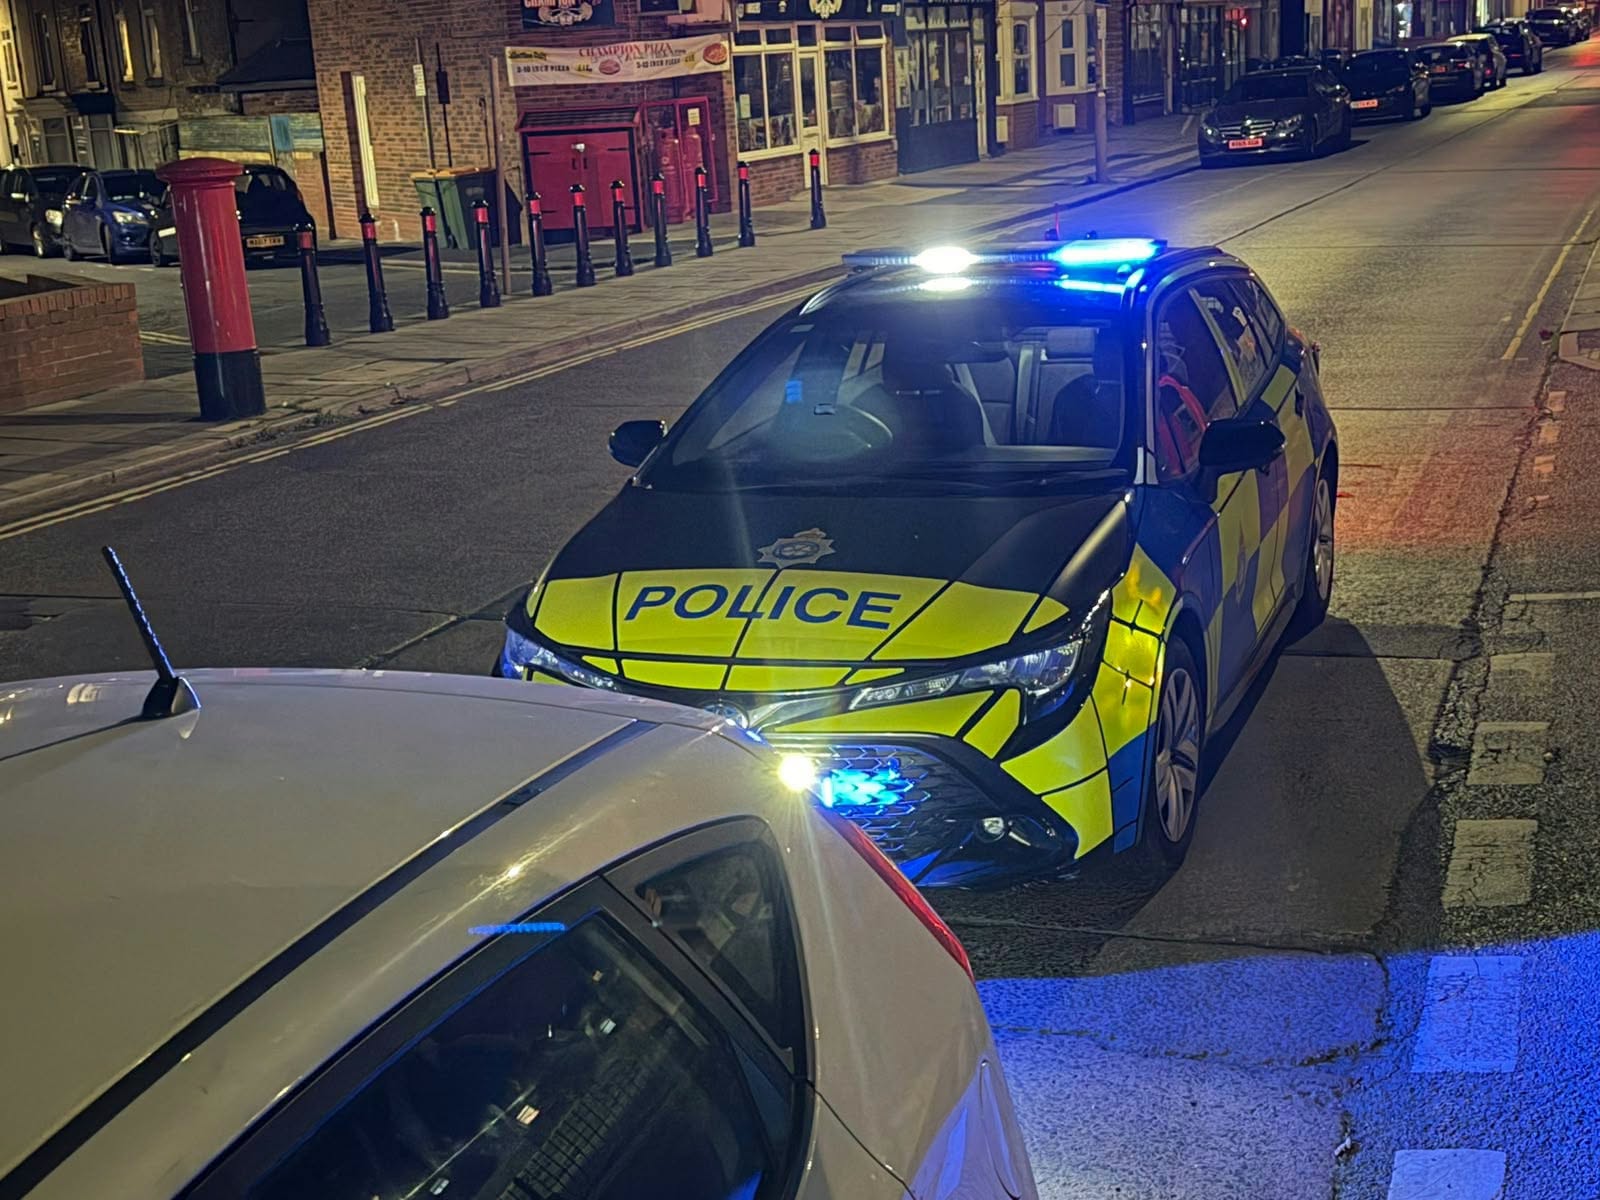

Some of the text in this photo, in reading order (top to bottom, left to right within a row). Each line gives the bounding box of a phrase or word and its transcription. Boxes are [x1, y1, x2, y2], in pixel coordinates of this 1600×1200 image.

[578, 42, 640, 57] CHAMPION
[644, 42, 673, 54] PIZZA
[550, 64, 570, 72] PIZZA
[624, 584, 901, 630] POLICE
